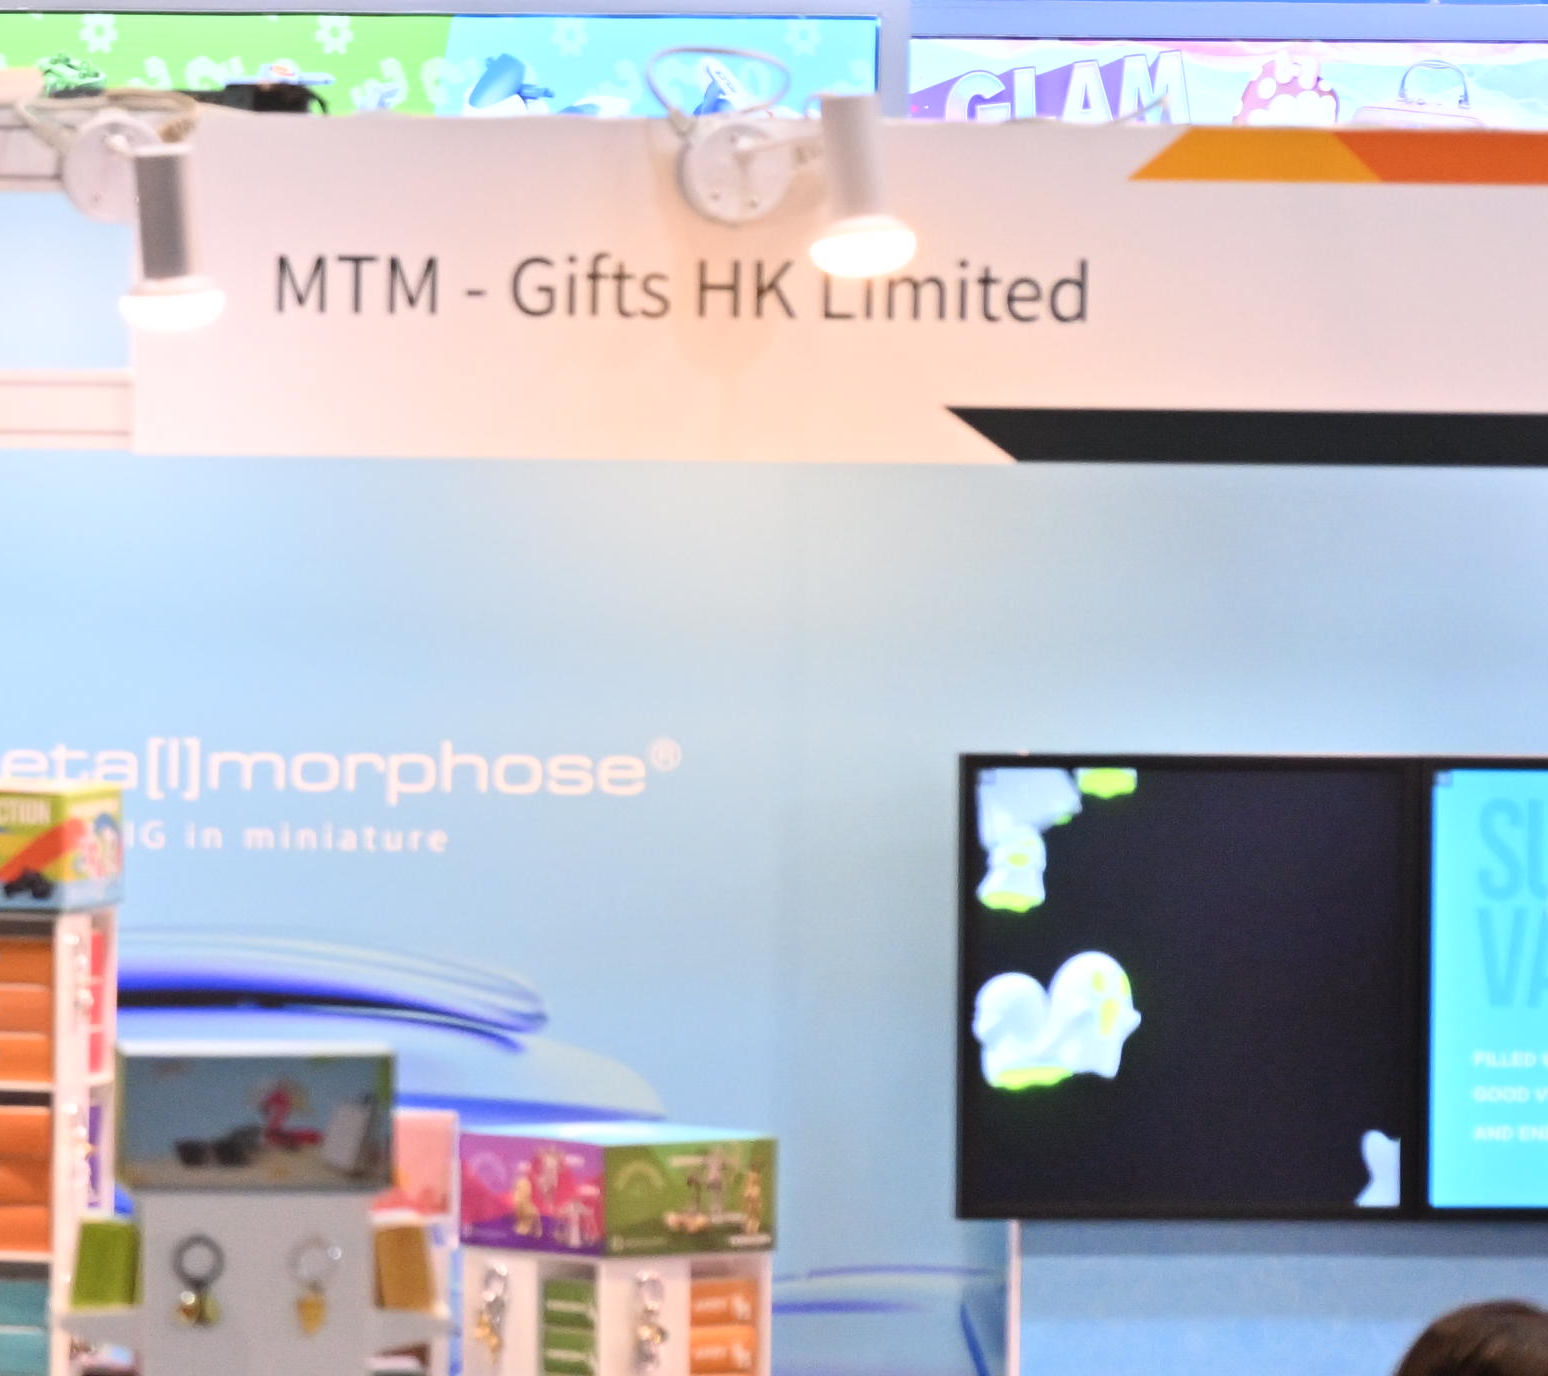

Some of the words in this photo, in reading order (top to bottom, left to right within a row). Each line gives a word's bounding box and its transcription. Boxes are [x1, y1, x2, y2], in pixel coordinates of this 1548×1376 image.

[274, 254, 441, 316] MTM
[510, 252, 671, 321] Gifts
[696, 259, 798, 321] HK
[822, 258, 1092, 324] Limited
[185, 823, 223, 852] in
[244, 823, 450, 853] miniature
